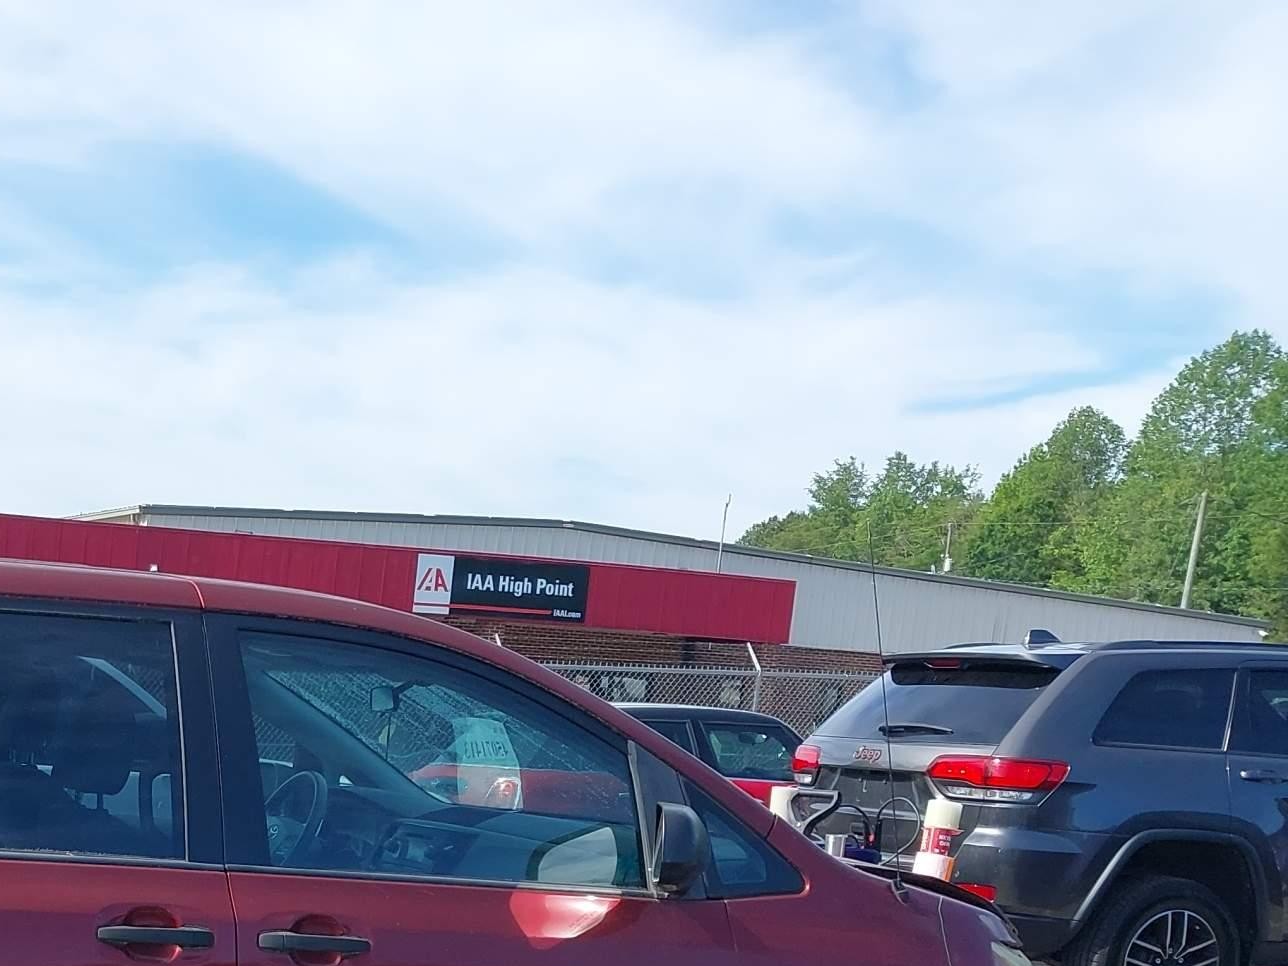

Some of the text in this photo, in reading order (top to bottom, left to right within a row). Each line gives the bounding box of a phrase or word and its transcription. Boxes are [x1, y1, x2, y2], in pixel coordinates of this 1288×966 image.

[466, 573, 574, 597] IAA High Point
[853, 745, 882, 764] Jeep
